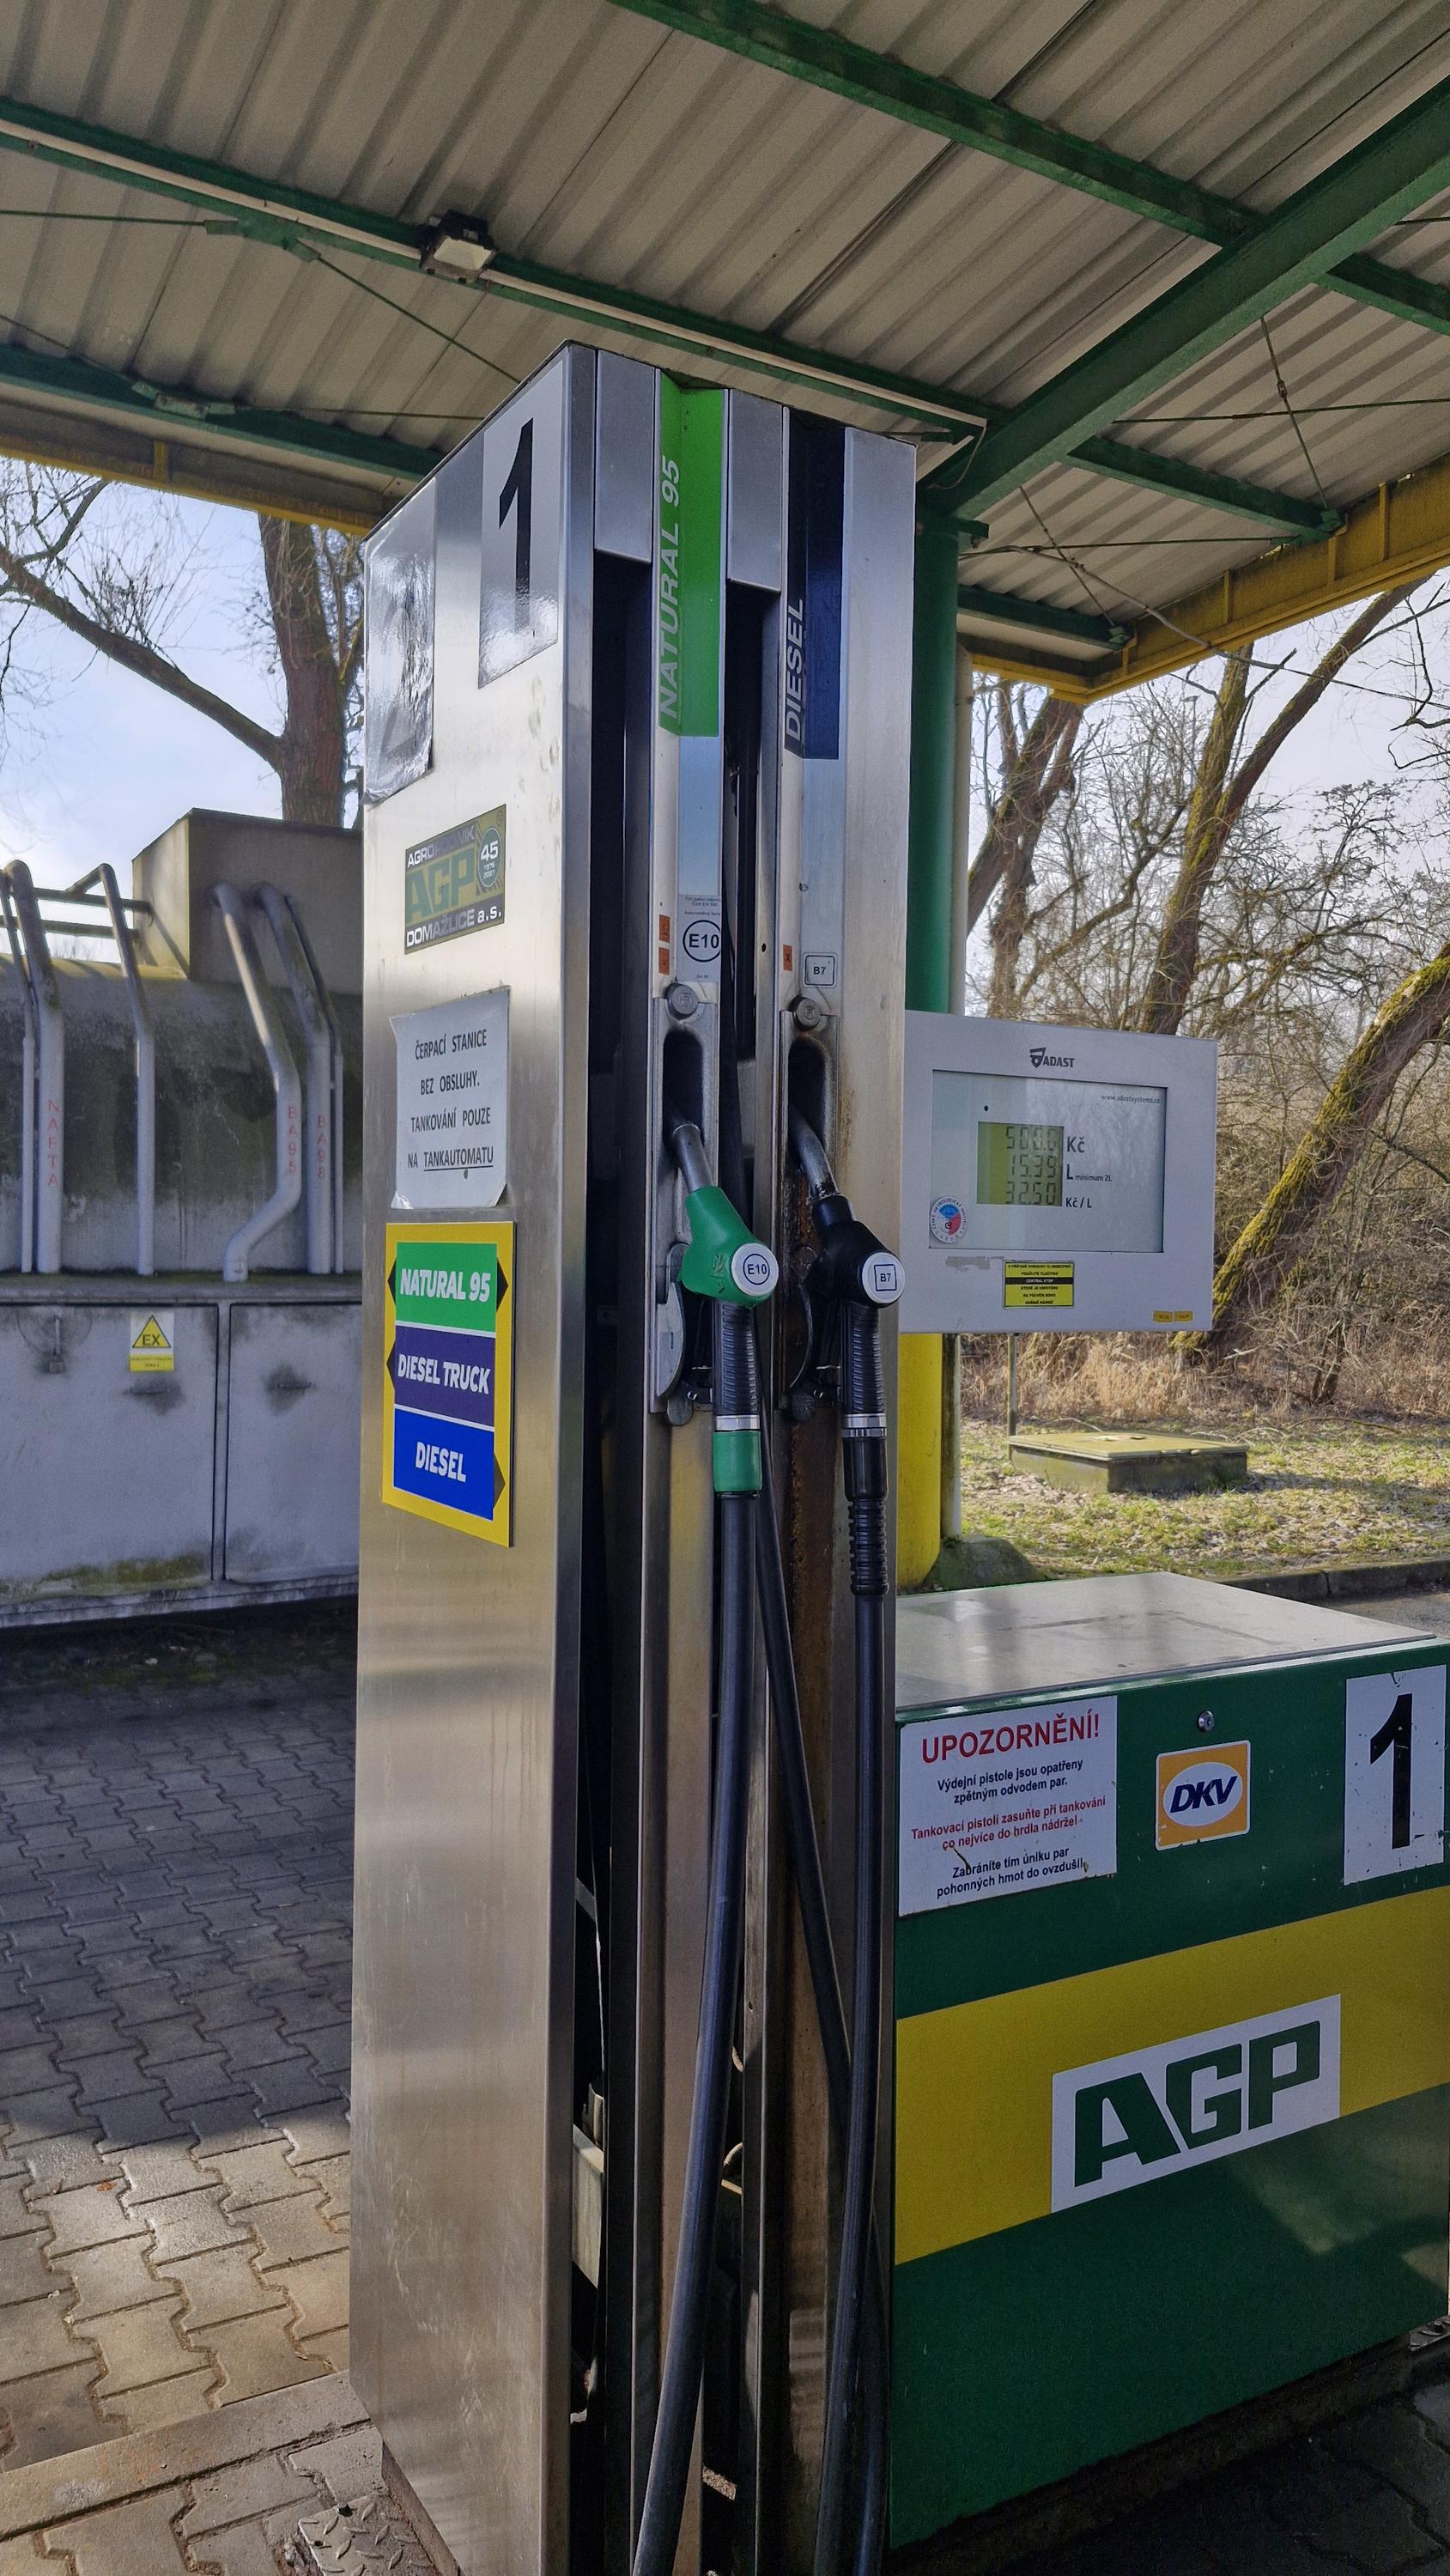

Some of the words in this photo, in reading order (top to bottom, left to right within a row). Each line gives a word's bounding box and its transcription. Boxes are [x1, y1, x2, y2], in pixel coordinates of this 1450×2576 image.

[661, 455, 680, 507] 95
[499, 417, 533, 630] 1
[659, 523, 679, 719] NATURAL
[786, 598, 804, 742] DIESEL
[407, 823, 476, 867] AGRONIK
[481, 841, 498, 861] 45
[406, 848, 475, 925] AGP
[406, 908, 475, 948] DOMAŽLICE
[477, 905, 501, 924] a.s.
[689, 933, 719, 949] E10
[813, 966, 826, 975] B7
[415, 1033, 446, 1060] ČERPACÍ
[452, 1029, 487, 1053] STANICE
[1043, 1055, 1075, 1067] ADAST
[421, 1078, 434, 1095] BEZ
[440, 1070, 480, 1093] OBSLUHY.
[411, 1107, 457, 1133] TANKOVÁNÍ
[462, 1107, 491, 1127] POUZE
[48, 1099, 59, 1187] NAFTA
[408, 1153, 418, 1169] NA
[424, 1146, 494, 1168] TANKAUTOMATU
[1067, 1136, 1085, 1153] Kč
[1067, 1164, 1073, 1180] L
[1065, 1197, 1077, 1208] Kč
[1087, 1198, 1092, 1208] L
[747, 1264, 767, 1275] E10
[880, 1273, 891, 1282] B7
[400, 1268, 466, 1300] NATURAL
[469, 1272, 491, 1303] 95
[143, 1334, 161, 1346] EX
[398, 1353, 440, 1384] DIESEL
[443, 1361, 490, 1394] TRUCK
[416, 1441, 466, 1483] DIESEL
[922, 1709, 1100, 1764] UPOZORNĚNÍ!
[937, 1774, 977, 1793] Výdejní
[980, 1770, 1013, 1787] pistole
[1016, 1766, 1038, 1782] jsou
[1040, 1759, 1083, 1777] opatřeny
[1370, 1692, 1413, 1850] 1
[954, 1789, 998, 1805] zpětným
[1000, 1781, 1047, 1795] odvodem
[1050, 1777, 1068, 1790] par.
[1170, 1776, 1238, 1814] DKV
[912, 1820, 964, 1839] Tankovací
[968, 1814, 999, 1832] pistoli
[1001, 1808, 1040, 1824] zasuňte
[1043, 1804, 1057, 1819] při
[1059, 1795, 1106, 1814] tankování
[942, 1839, 956, 1850] co
[958, 1832, 995, 1847] nejvíce
[998, 1828, 1010, 1839] do
[1013, 1823, 1039, 1838] hrdla
[952, 1860, 1001, 1878] Zabráníte
[1004, 1856, 1020, 1868] tím
[1022, 1850, 1050, 1864] úniku
[1053, 1848, 1070, 1861] par
[937, 1875, 995, 1899] pohonných
[998, 1870, 1024, 1884] hmot
[1027, 1868, 1039, 1879] do
[1074, 2020, 1320, 2188] AGP
